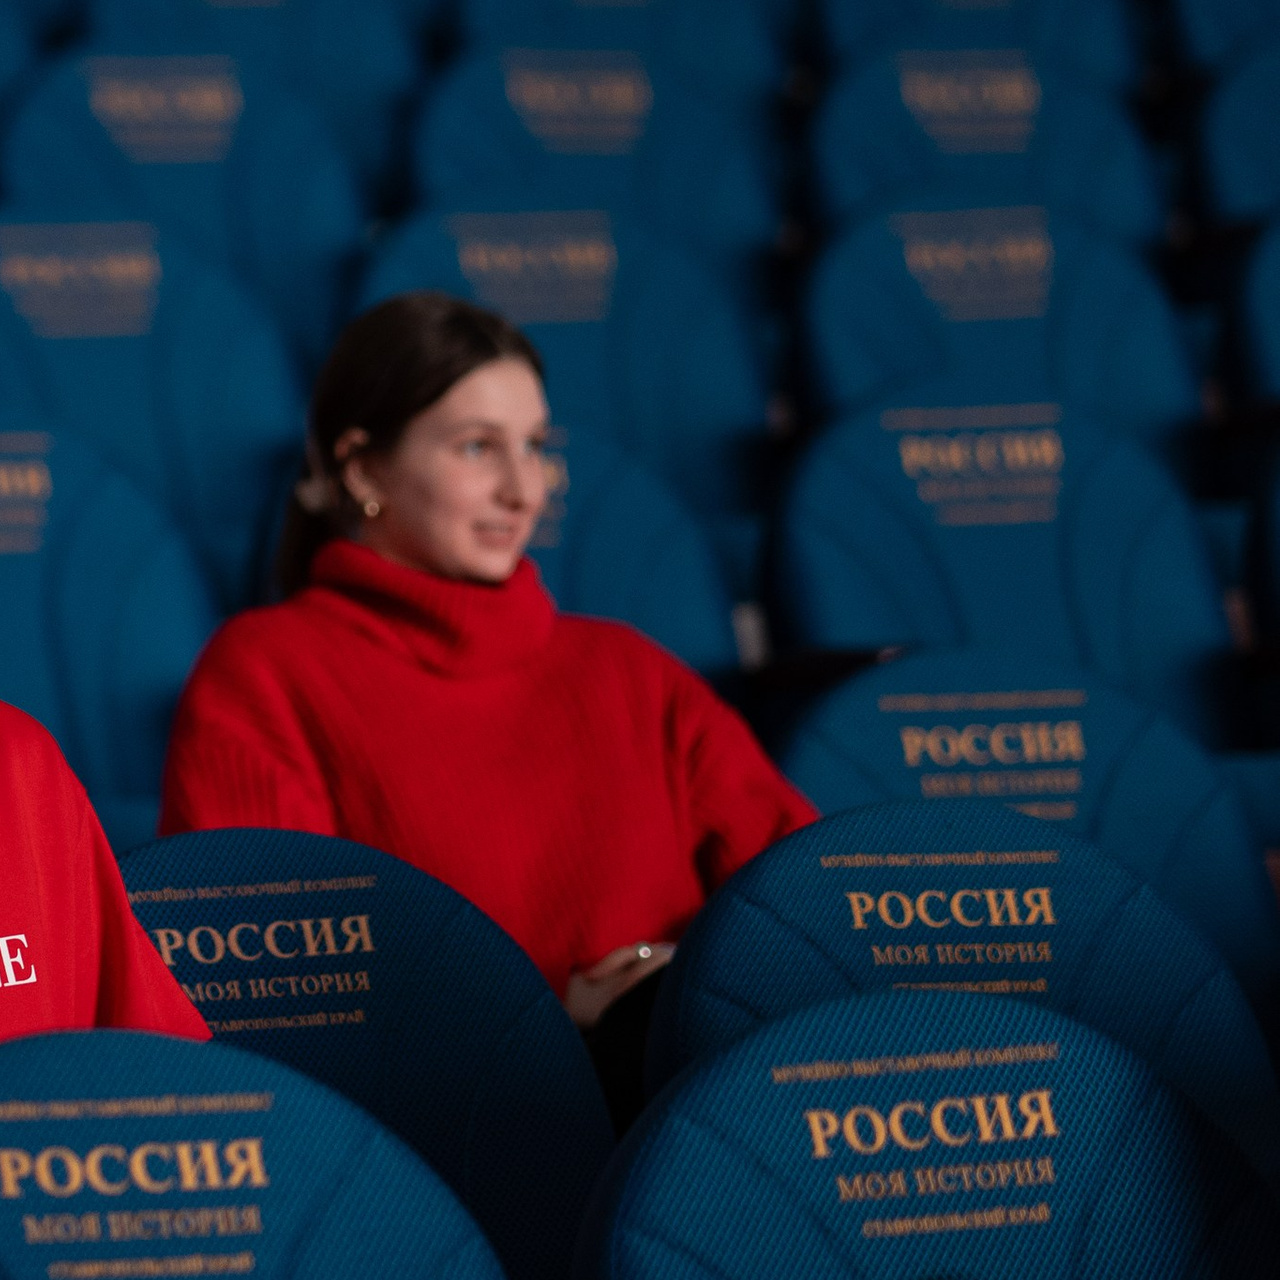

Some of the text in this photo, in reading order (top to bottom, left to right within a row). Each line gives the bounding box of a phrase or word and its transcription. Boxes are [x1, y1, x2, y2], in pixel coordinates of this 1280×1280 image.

[846, 887, 1057, 929] РОССИЯ
[152, 914, 375, 967] РОССИЯ
[872, 941, 1053, 965] МОЯ ИСТОРИЯ
[181, 971, 371, 1003] МОЯ ИСТОРИЯ
[804, 1088, 1060, 1160] РОССИЯ
[836, 1156, 1055, 1202] МОЯ ИСТОРИЯ
